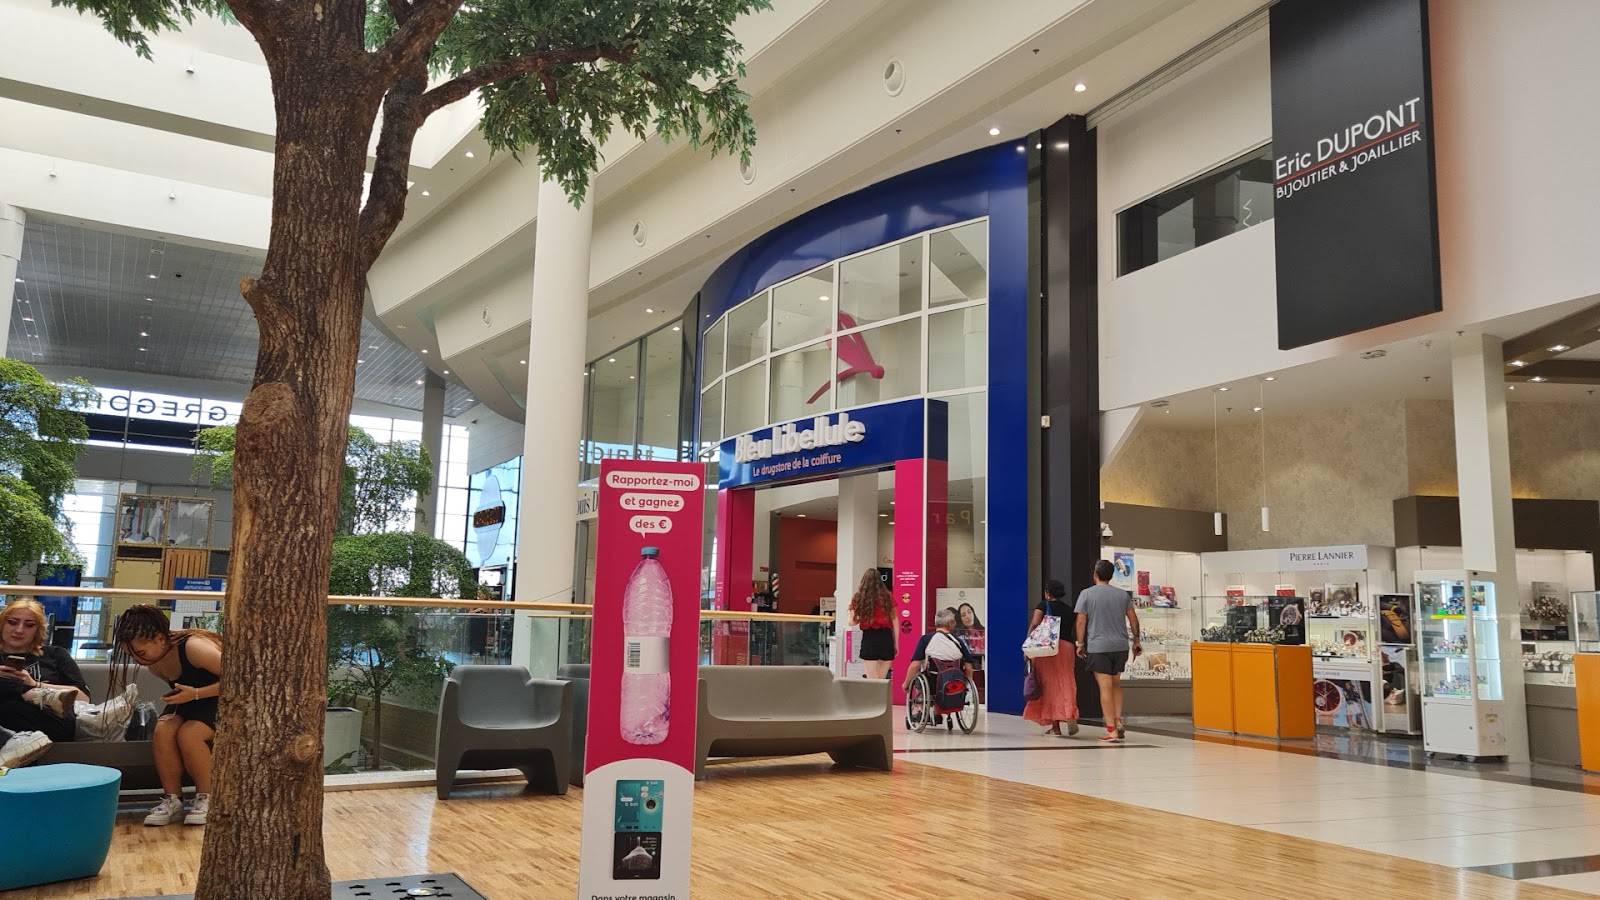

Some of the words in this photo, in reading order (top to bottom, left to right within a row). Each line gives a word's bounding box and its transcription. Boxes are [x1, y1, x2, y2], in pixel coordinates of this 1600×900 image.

[1275, 151, 1312, 180] Eric
[1317, 96, 1420, 162] DUPONT
[1276, 164, 1337, 199] BIJOUTIER
[1338, 160, 1349, 173] &
[1350, 130, 1422, 172] JOAILLIER
[735, 434, 772, 463] Bleu
[772, 412, 866, 455] Libellule
[752, 466, 760, 477] Le
[761, 461, 792, 477] drugstore
[792, 458, 802, 470] de
[802, 457, 810, 468] la
[811, 452, 842, 467] coiffure
[612, 474, 694, 487] Rapportez-moi
[624, 497, 636, 506] et
[638, 498, 680, 508] gagnez
[635, 519, 655, 529] des
[658, 519, 667, 529] €
[1289, 552, 1317, 562] PIERRE
[1318, 551, 1355, 561] LANNIER
